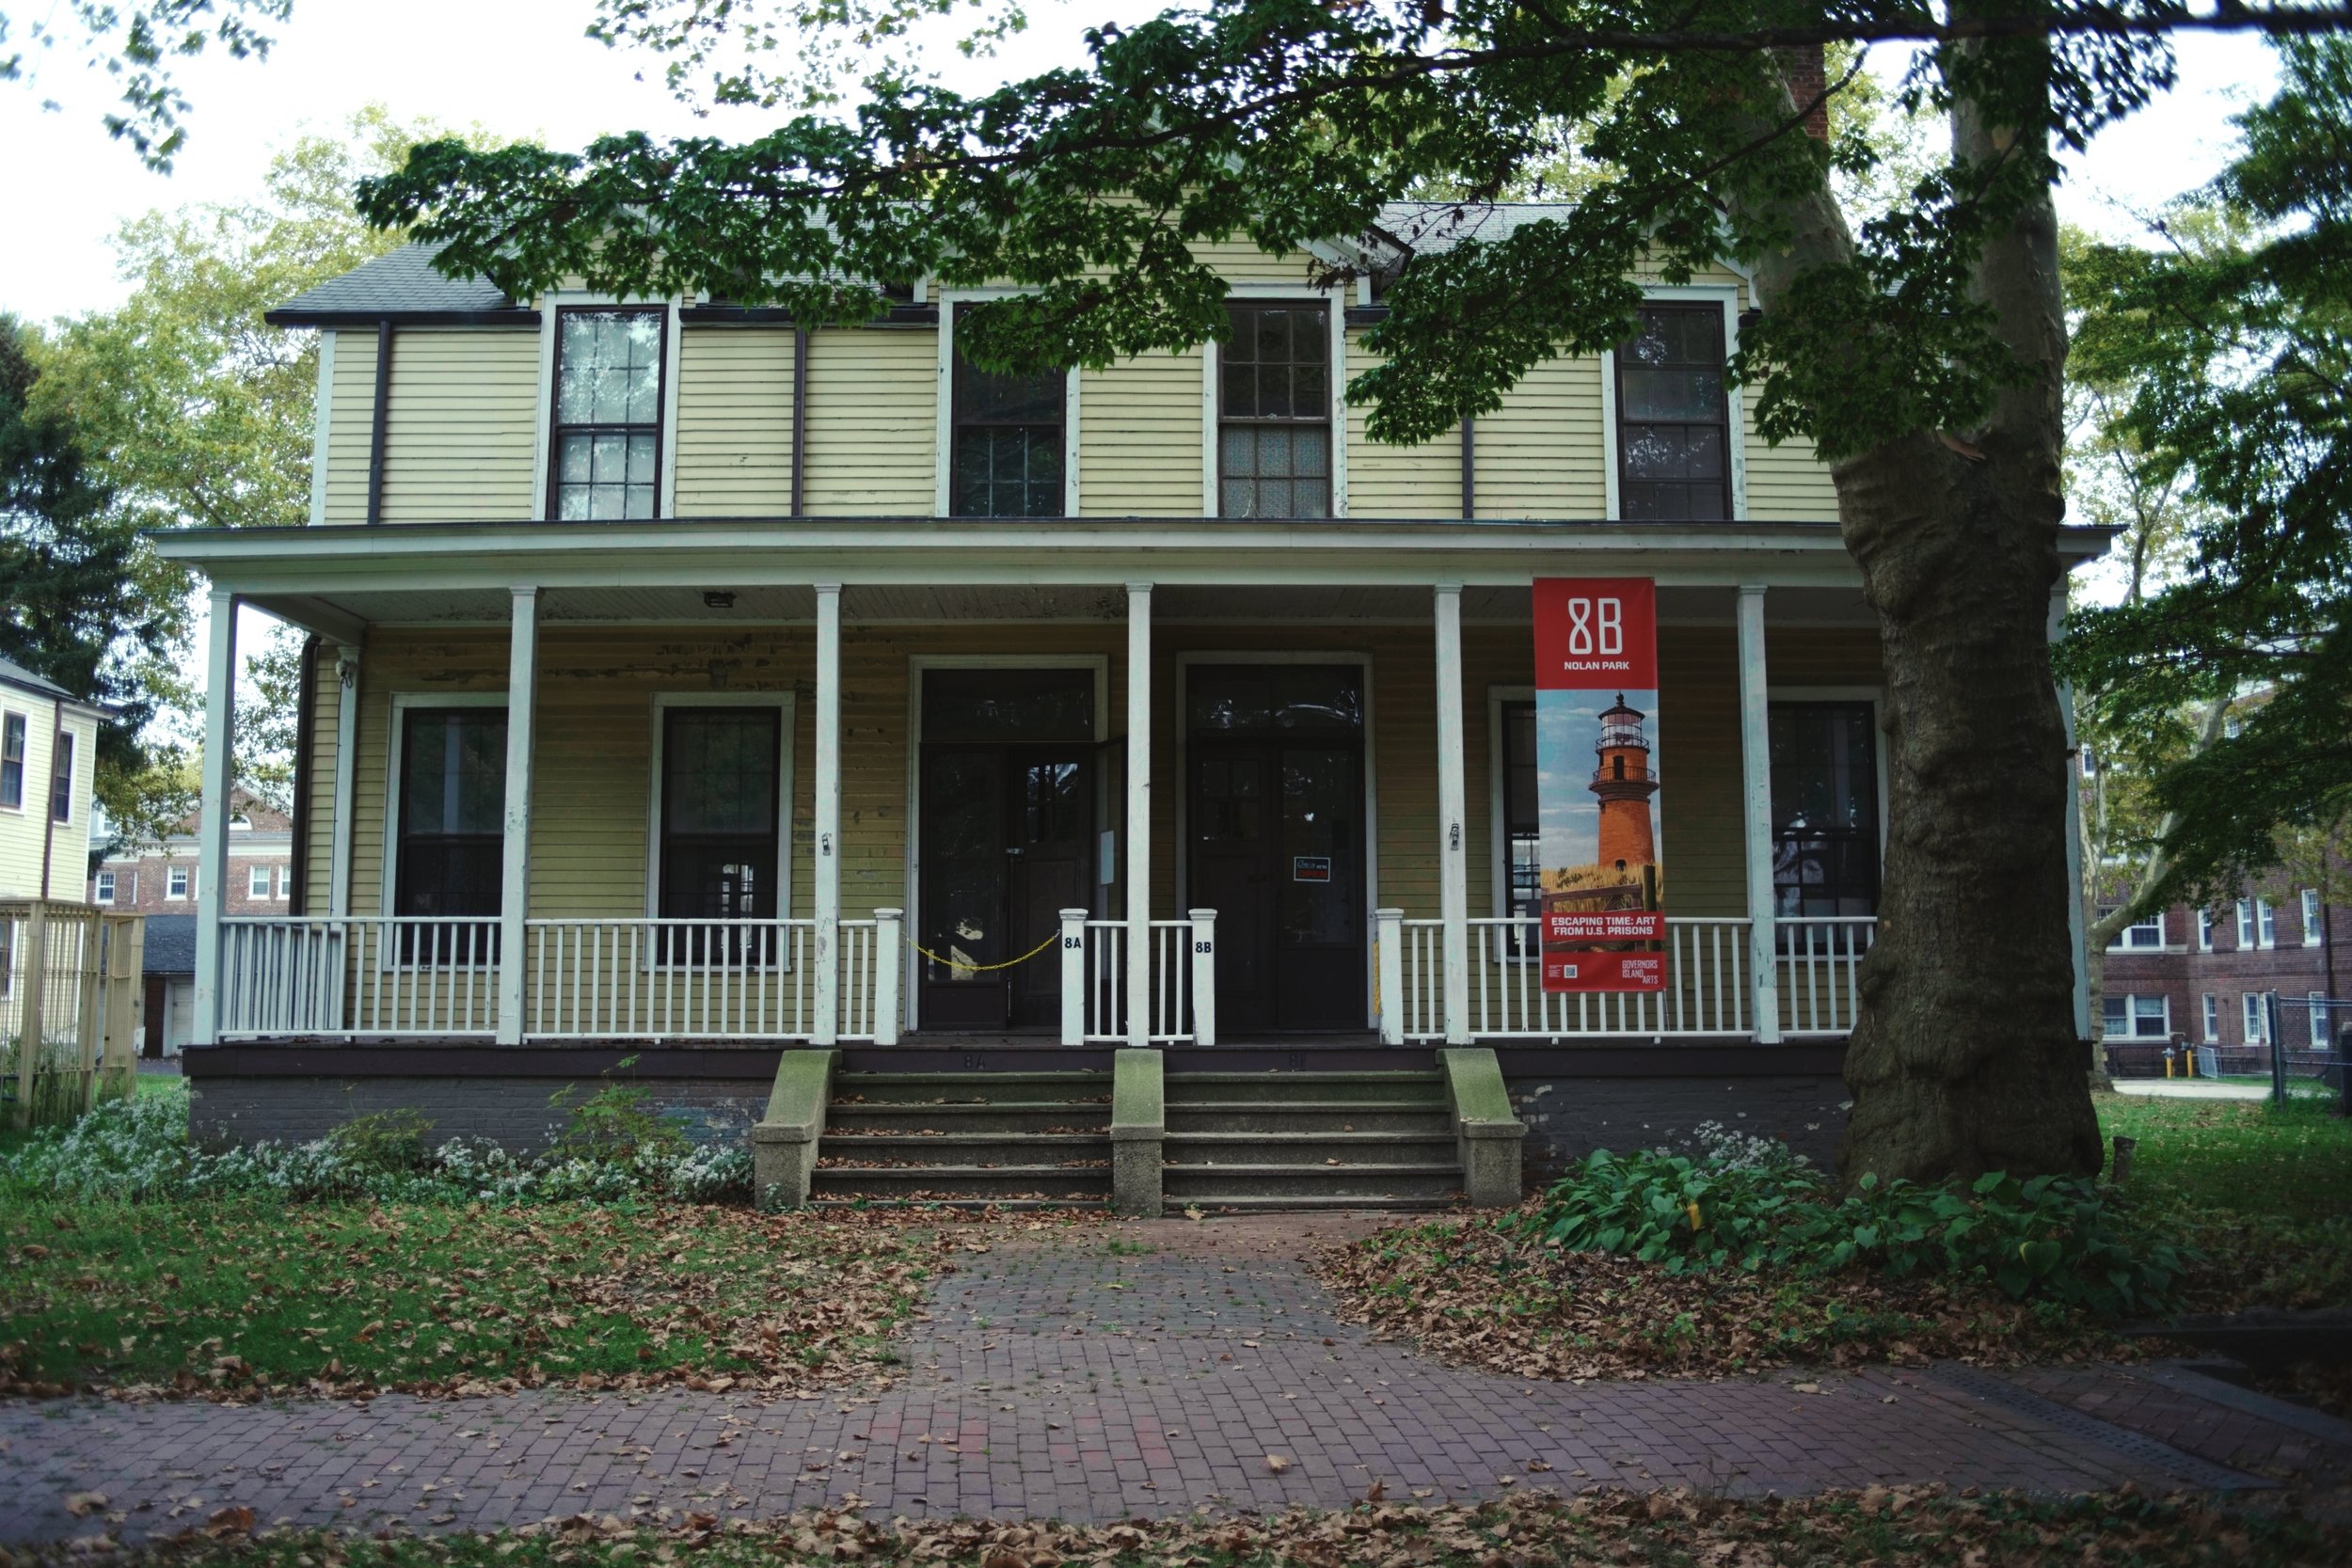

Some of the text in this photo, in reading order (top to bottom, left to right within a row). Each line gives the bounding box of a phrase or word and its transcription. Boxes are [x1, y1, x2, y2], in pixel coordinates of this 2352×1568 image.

[1567, 597, 1623, 655] 8B
[1564, 661, 1629, 671] NOLAN PARK
[1550, 916, 1657, 927] ESCAPING TIME: ART
[1553, 926, 1653, 936] FROM U.S. PRISONS
[1064, 937, 1082, 949] 8A
[1195, 942, 1212, 954] 8B
[1622, 959, 1659, 969] GOVERNORS
[1622, 969, 1644, 978] ISLAND
[1643, 975, 1659, 985] ARTS
[963, 1053, 986, 1069] 8A
